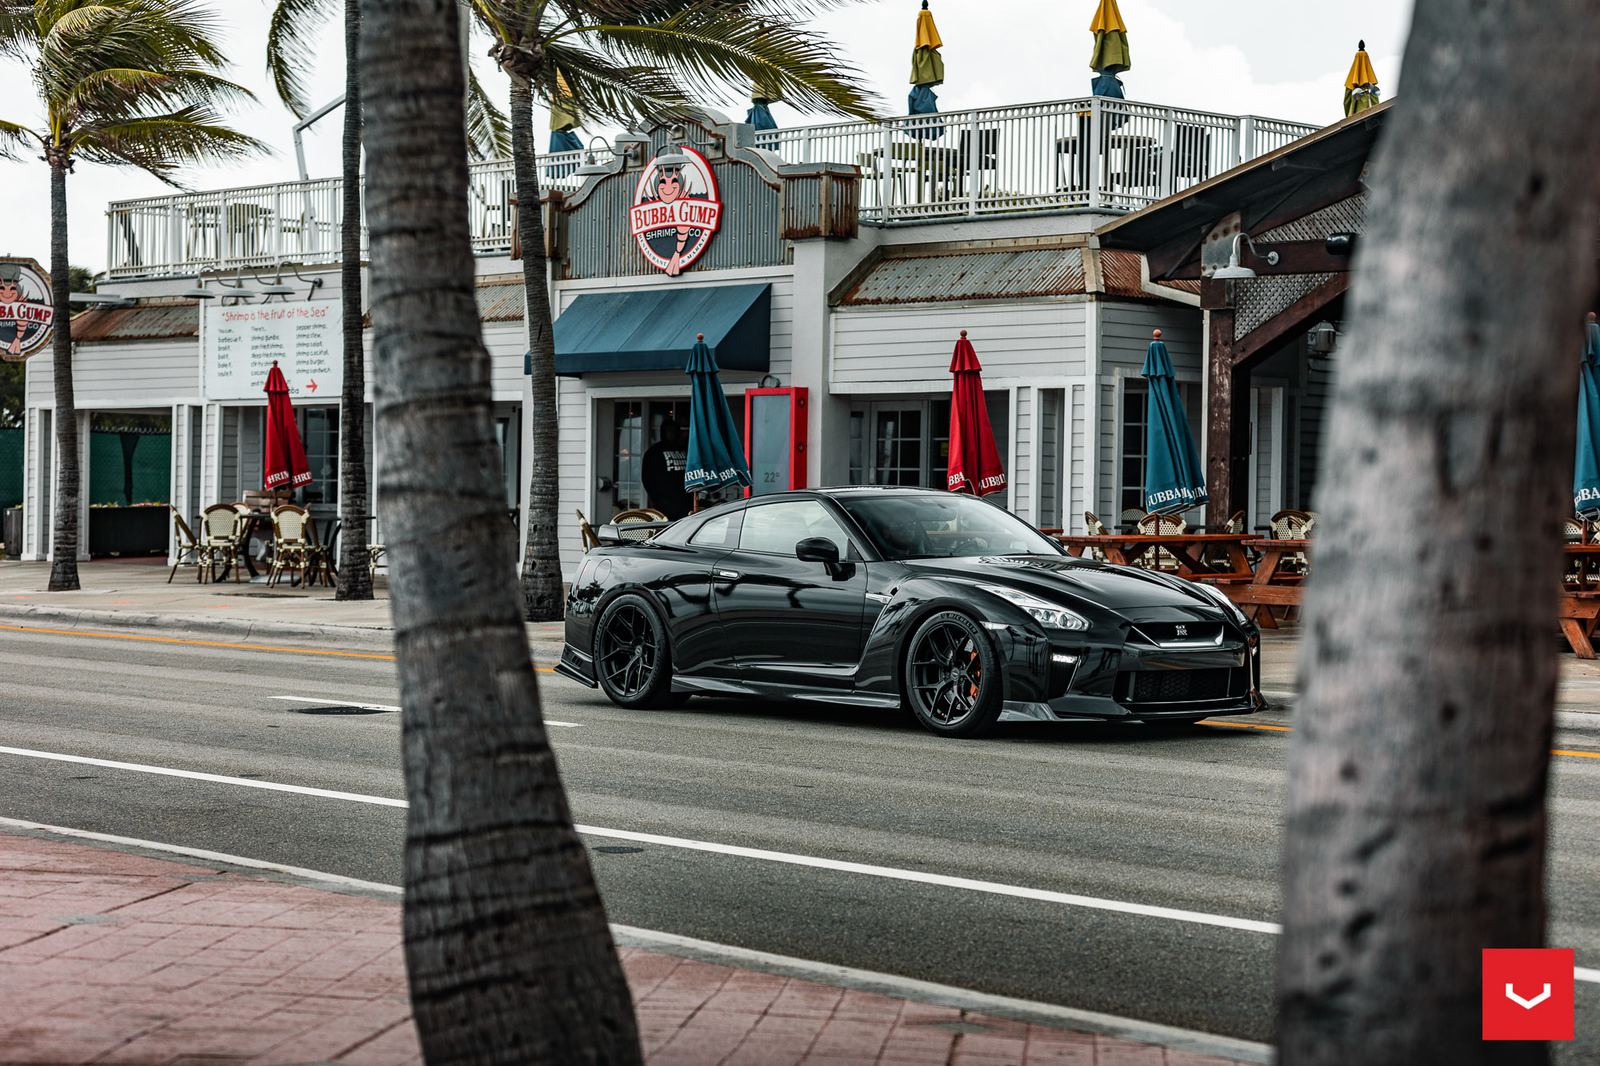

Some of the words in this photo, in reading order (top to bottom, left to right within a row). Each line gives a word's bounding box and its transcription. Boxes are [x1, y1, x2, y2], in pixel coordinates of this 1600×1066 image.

[634, 205, 676, 230] BUBBA
[679, 201, 717, 225] GUMP
[645, 228, 677, 240] SHRIMP
[688, 228, 701, 238] CO
[17, 303, 52, 322] GUMP
